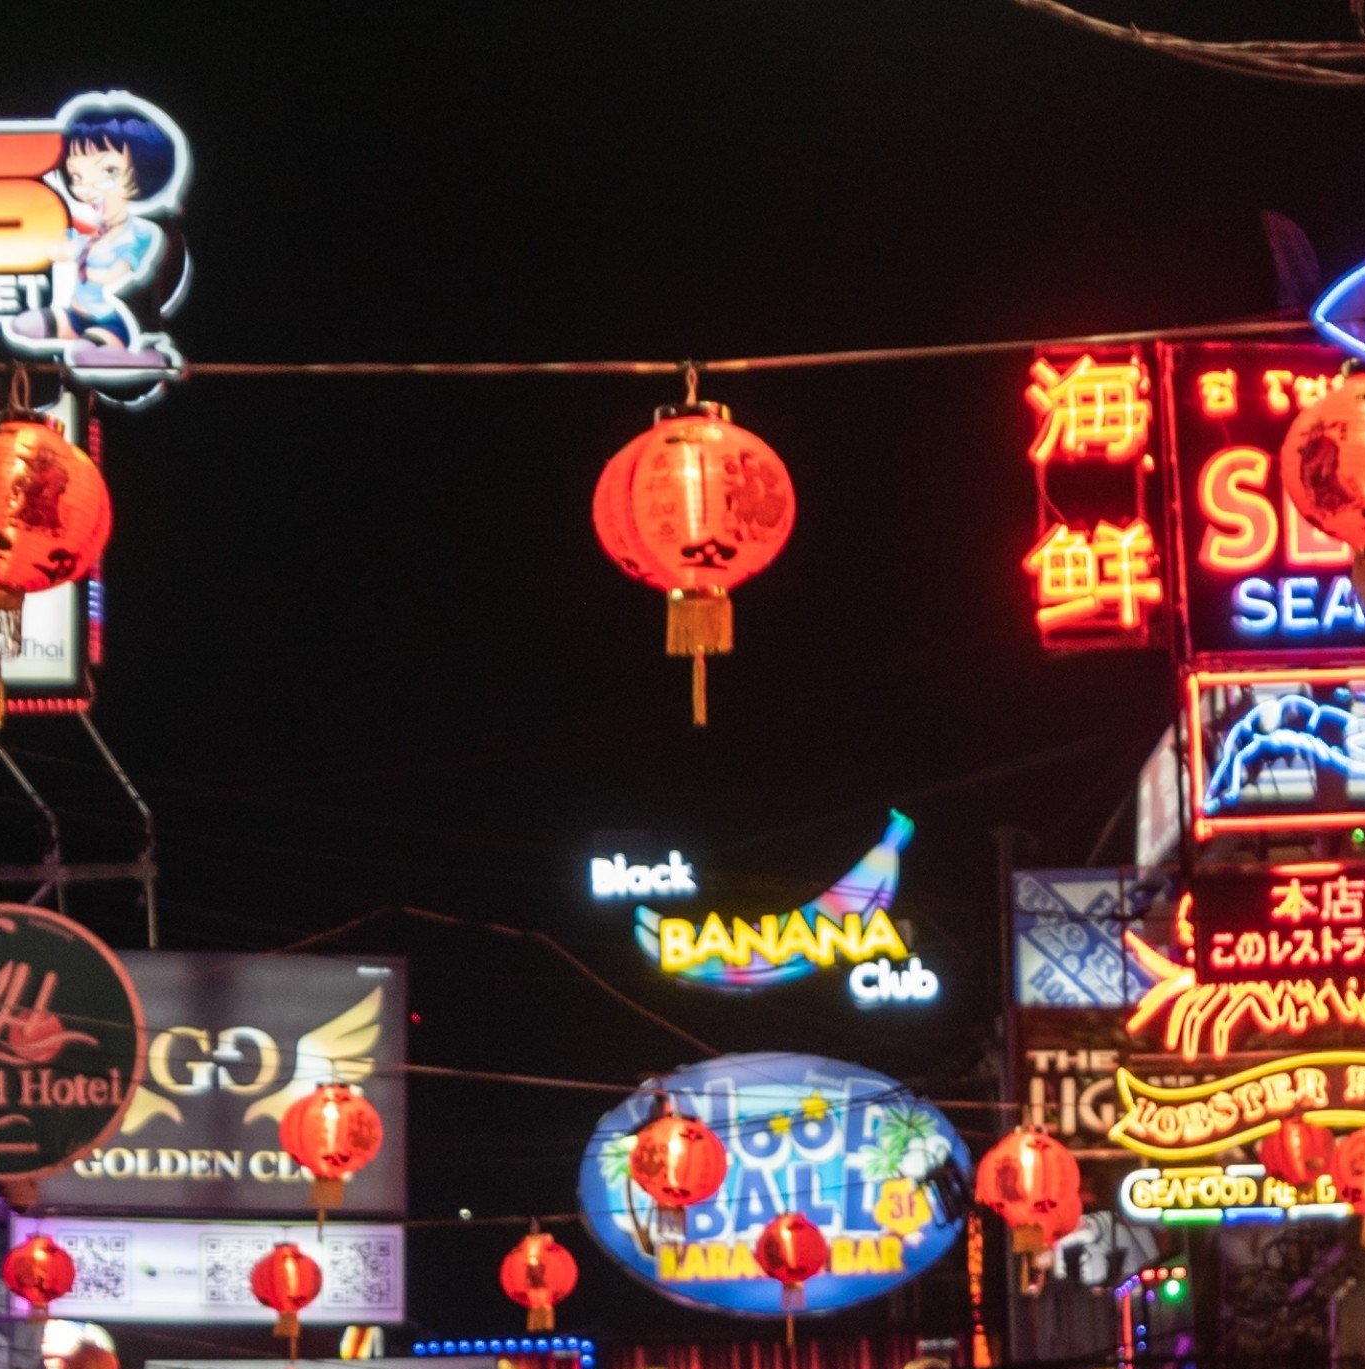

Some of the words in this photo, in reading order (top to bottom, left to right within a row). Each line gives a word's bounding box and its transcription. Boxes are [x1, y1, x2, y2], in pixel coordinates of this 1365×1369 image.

[590, 850, 696, 896] Black
[659, 907, 910, 972] BANANA
[848, 957, 940, 1003] Club
[1025, 1050, 1120, 1070] THE
[20, 1066, 125, 1108] Hotel
[1029, 1077, 1118, 1136] LIG
[1134, 1066, 1329, 1146] LOBSTER
[73, 1147, 246, 1182] GOLDEN
[1133, 1176, 1258, 1208] SEAFOOD
[829, 1235, 904, 1274] BAR
